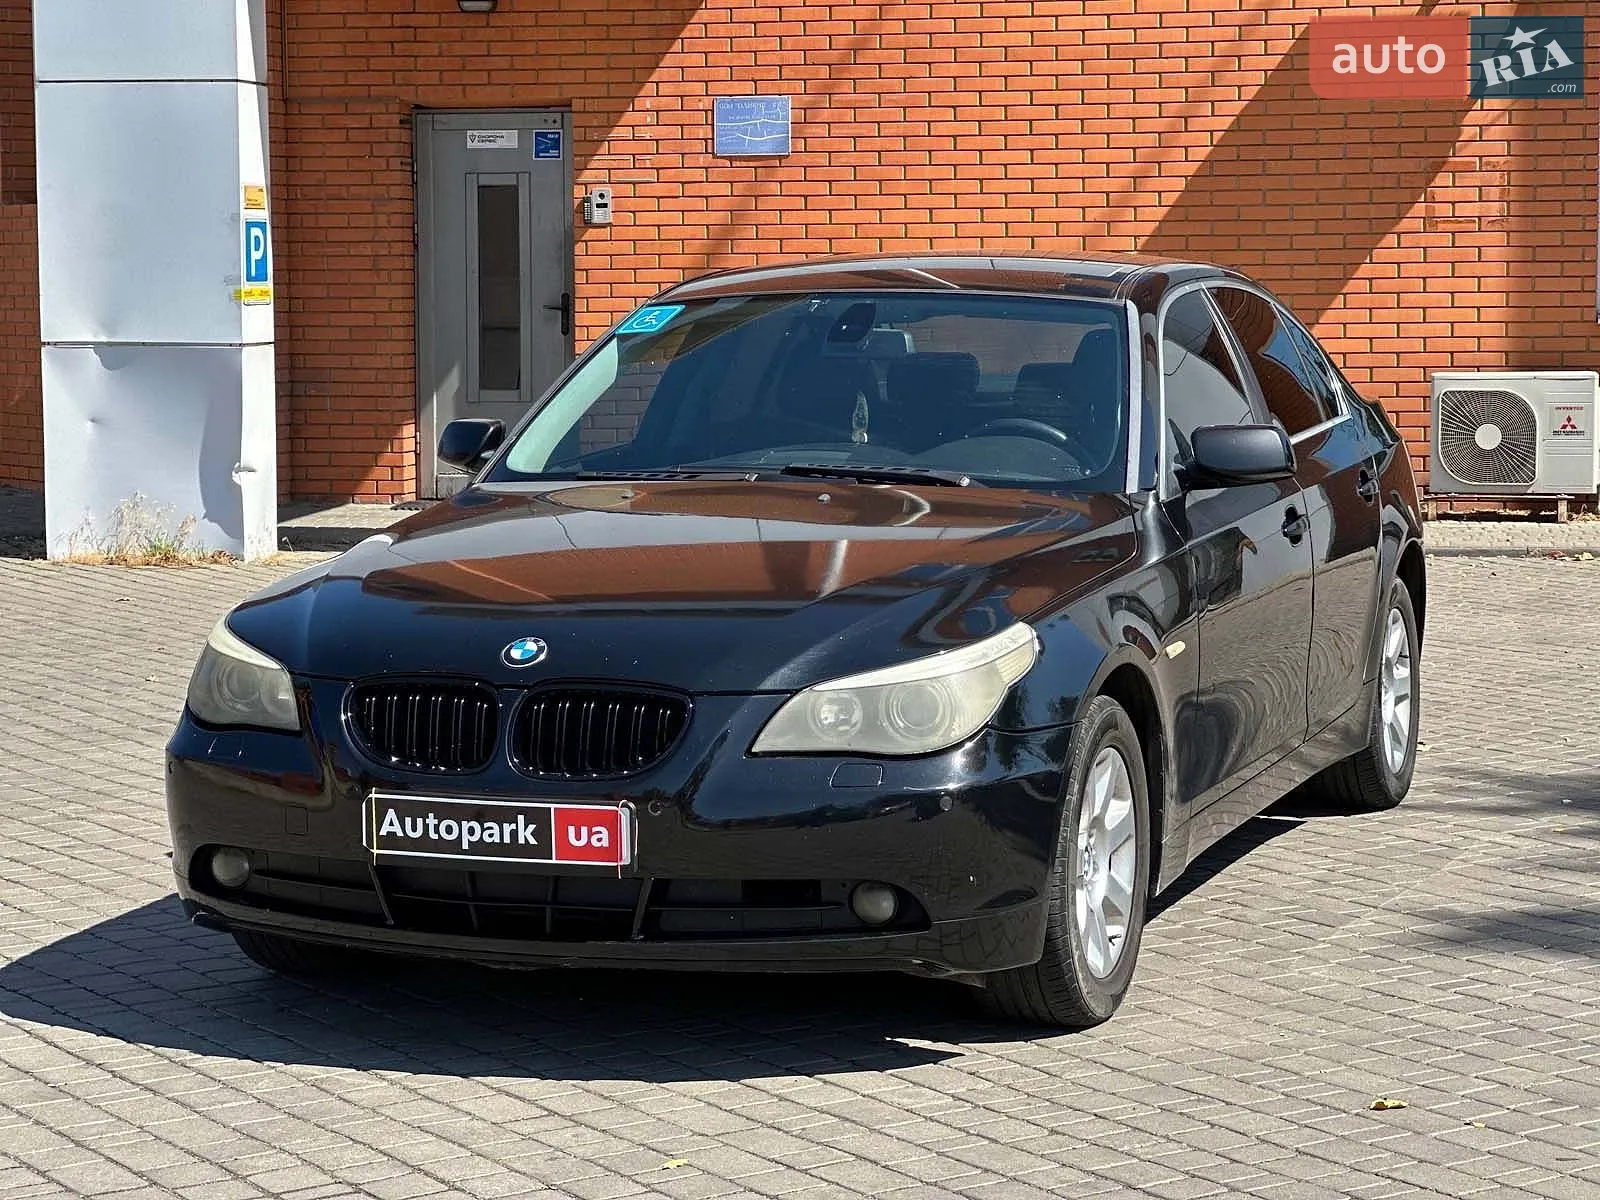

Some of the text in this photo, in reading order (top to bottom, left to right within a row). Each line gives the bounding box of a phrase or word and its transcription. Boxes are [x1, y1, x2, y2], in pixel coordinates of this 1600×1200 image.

[250, 227, 265, 277] P
[379, 808, 609, 850] Autopark ua
